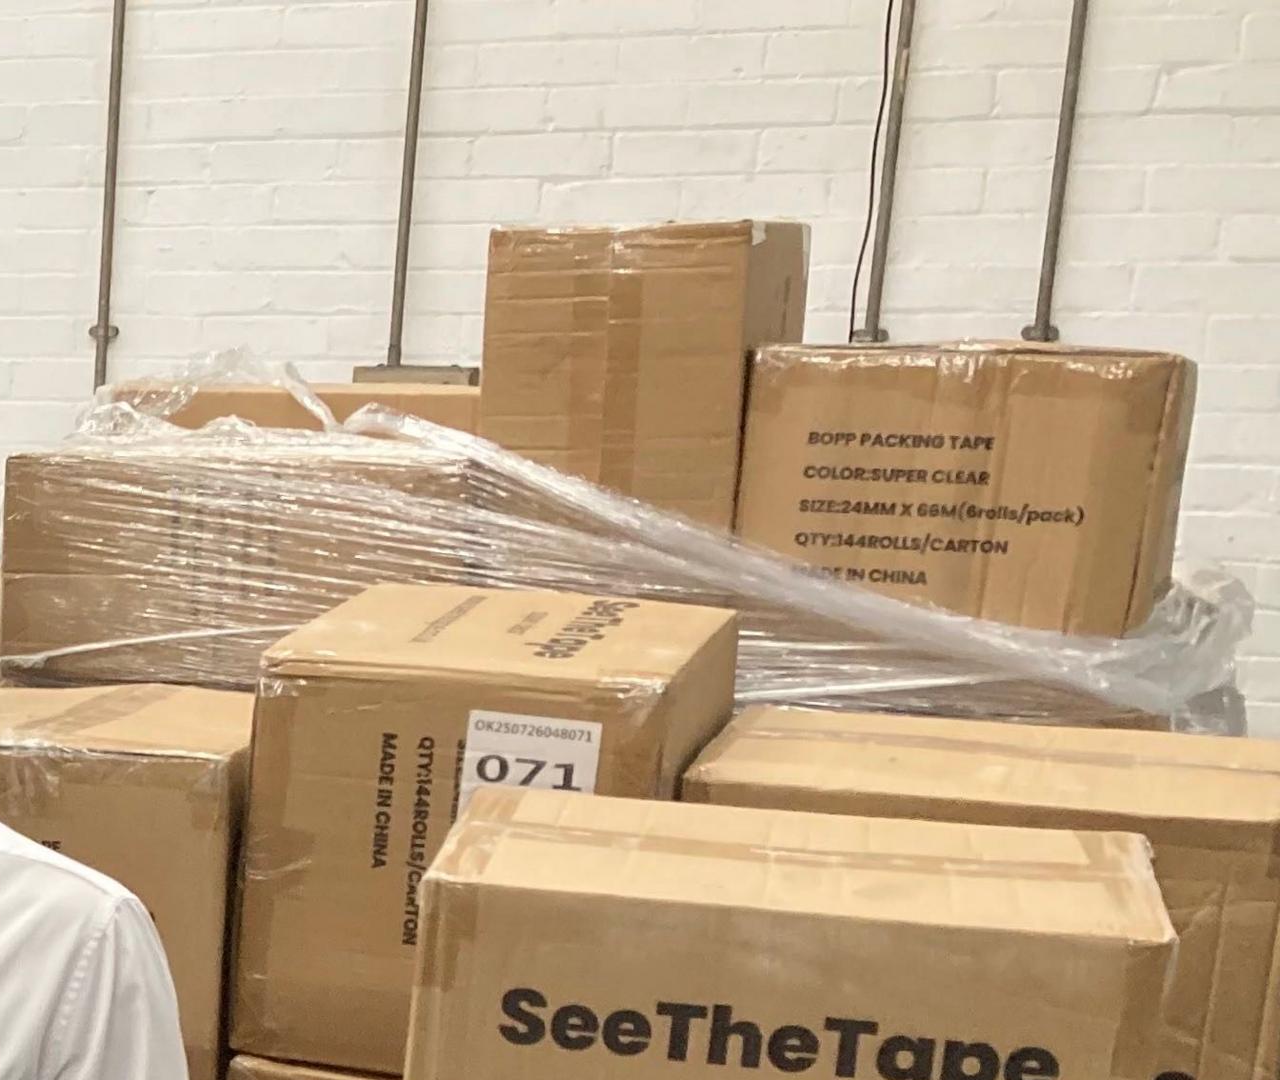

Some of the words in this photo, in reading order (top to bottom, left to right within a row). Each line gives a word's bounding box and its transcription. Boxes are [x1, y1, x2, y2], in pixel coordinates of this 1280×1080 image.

[807, 431, 856, 446] BOPP
[860, 433, 945, 450] PACKING
[949, 435, 996, 451] TAPE
[803, 465, 928, 484] COLOR:SUPER
[931, 469, 991, 486] CLEAR
[798, 498, 897, 518] SIZE:24MM
[899, 503, 914, 519] X
[845, 567, 864, 581] IN
[868, 567, 928, 586] CHINA
[377, 732, 399, 787] MADE
[476, 754, 582, 792] 071
[375, 787, 394, 809] IN
[371, 811, 392, 869] CHINA
